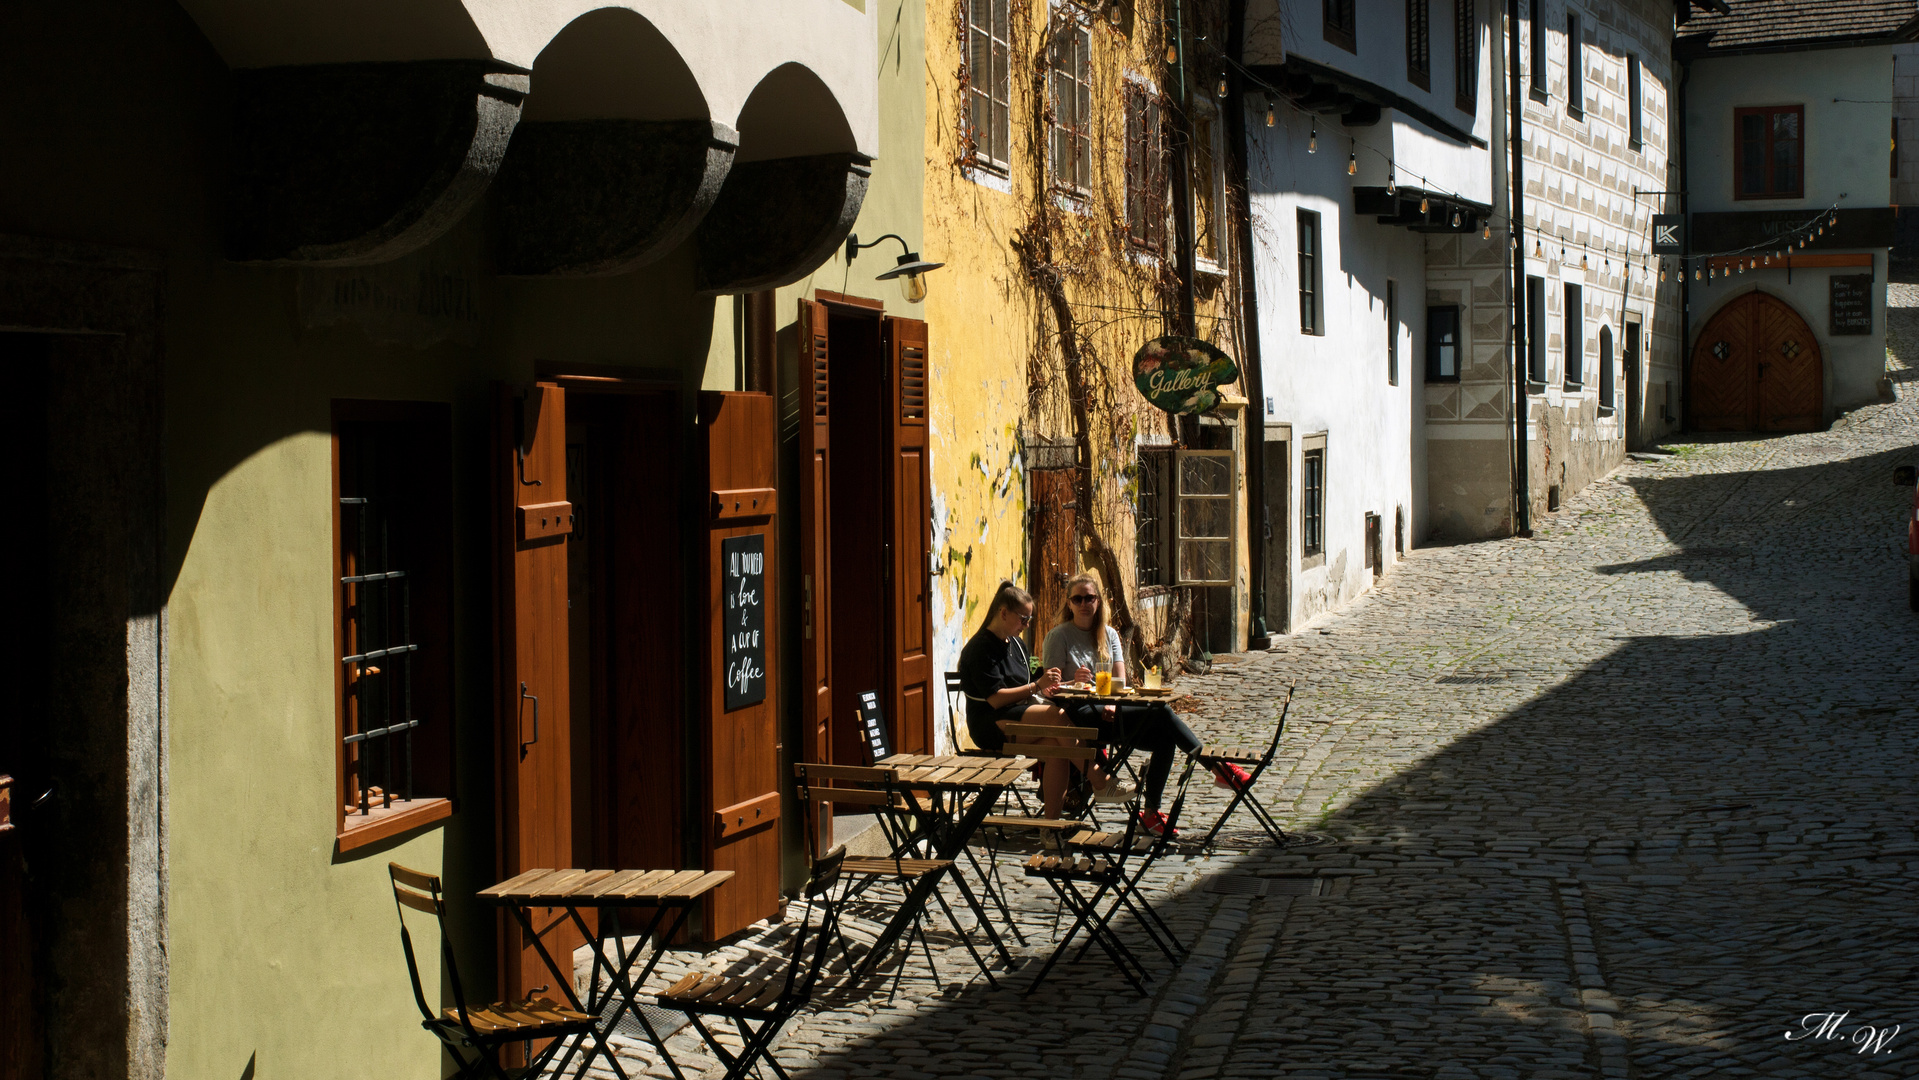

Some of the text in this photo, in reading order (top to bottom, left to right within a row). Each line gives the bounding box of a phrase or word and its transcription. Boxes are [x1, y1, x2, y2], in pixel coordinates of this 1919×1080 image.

[1852, 289, 1863, 298] buy
[1149, 368, 1215, 399] Gallery
[730, 552, 764, 577] ALL YOU NEED
[730, 577, 759, 609] is love
[741, 608, 749, 627] &
[731, 629, 759, 653] A CUP OF
[728, 656, 764, 695] Coffee
